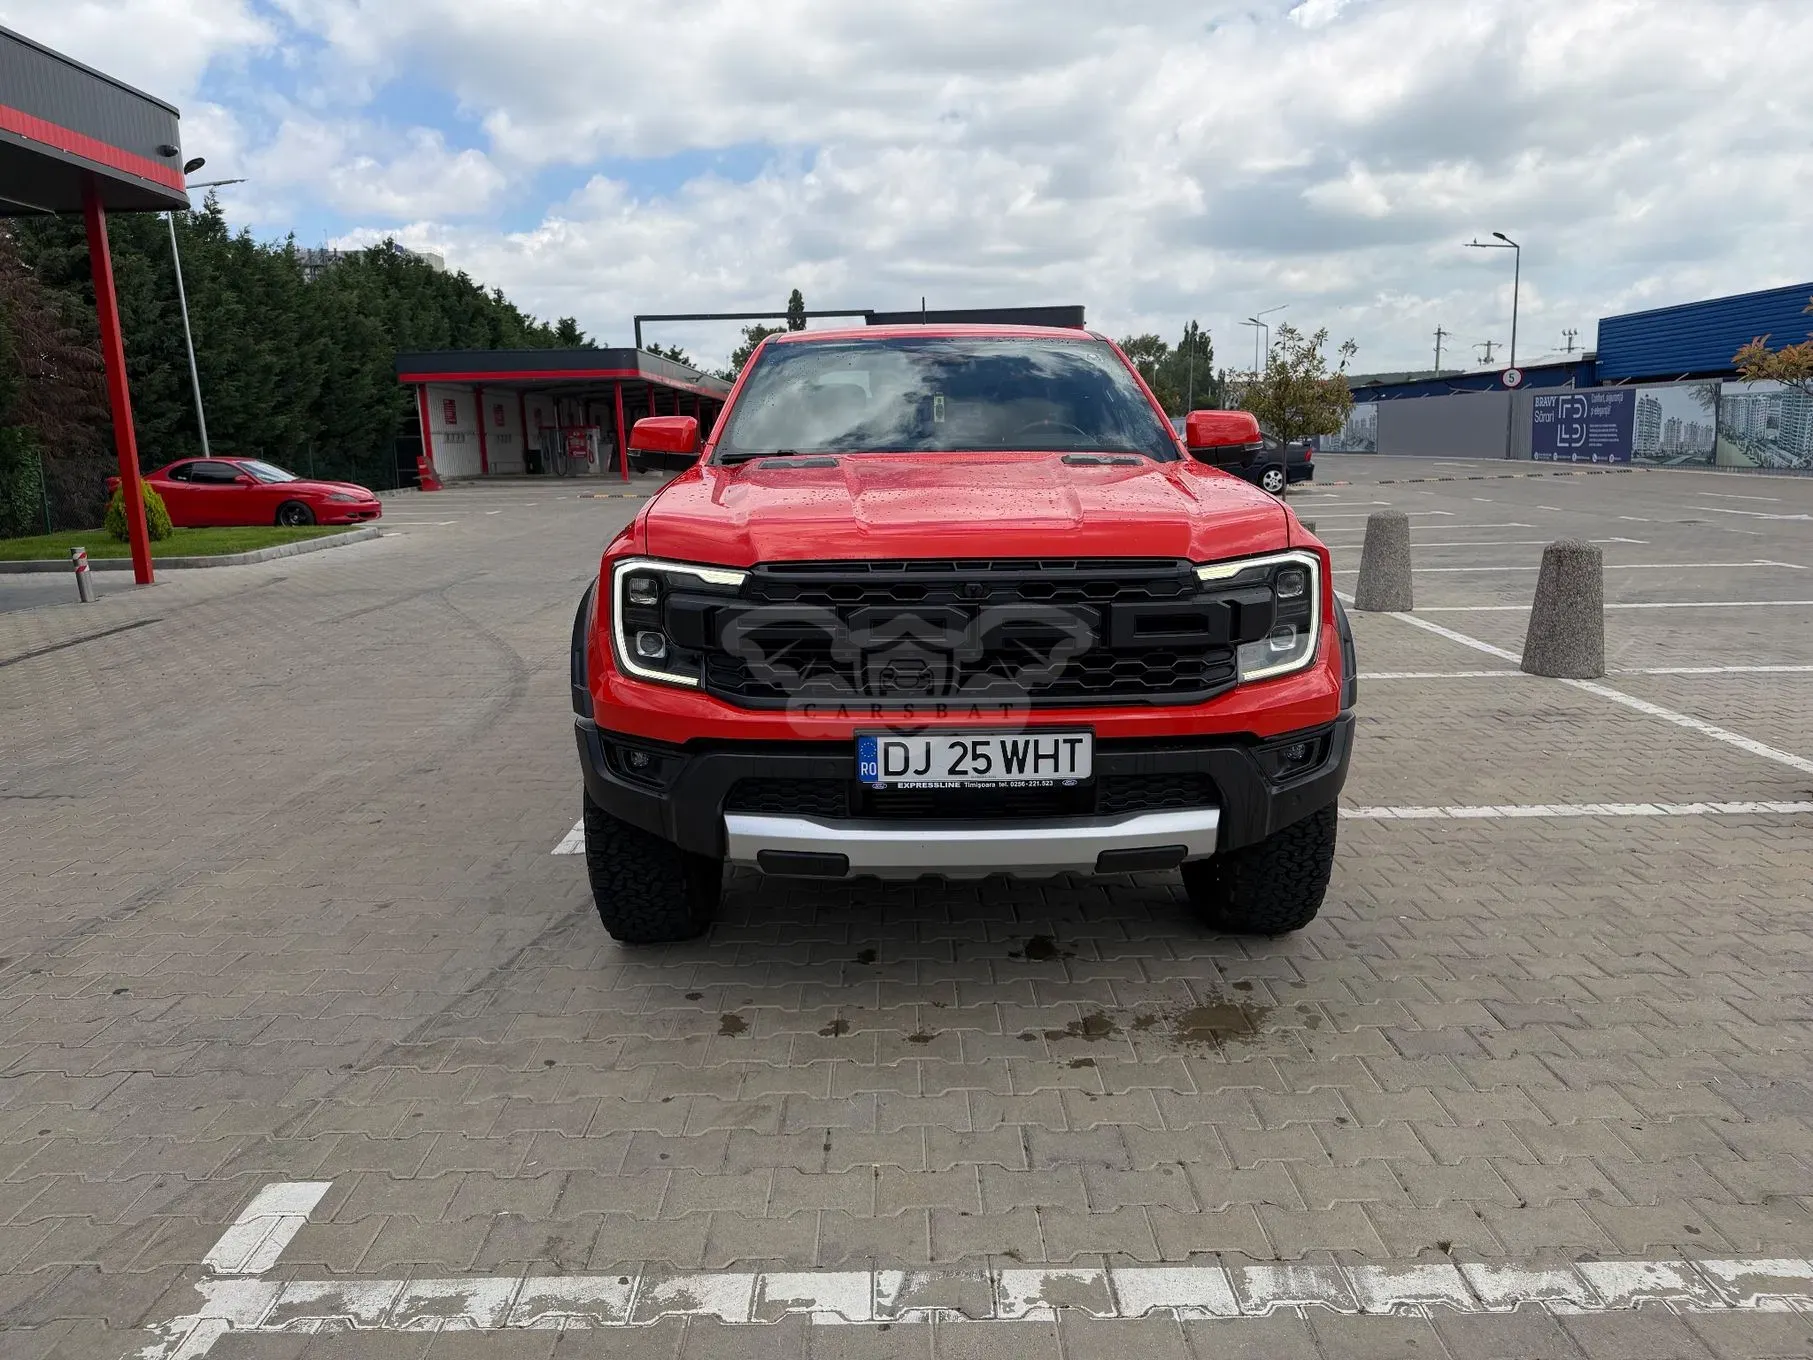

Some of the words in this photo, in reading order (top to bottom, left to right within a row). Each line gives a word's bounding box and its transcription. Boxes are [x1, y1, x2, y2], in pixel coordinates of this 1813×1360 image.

[1508, 373, 1515, 383] 5
[1534, 395, 1557, 407] BRAVY
[883, 741, 932, 777] DJ
[947, 740, 993, 776] 25
[999, 738, 1084, 775] WHT
[860, 762, 877, 776] RO
